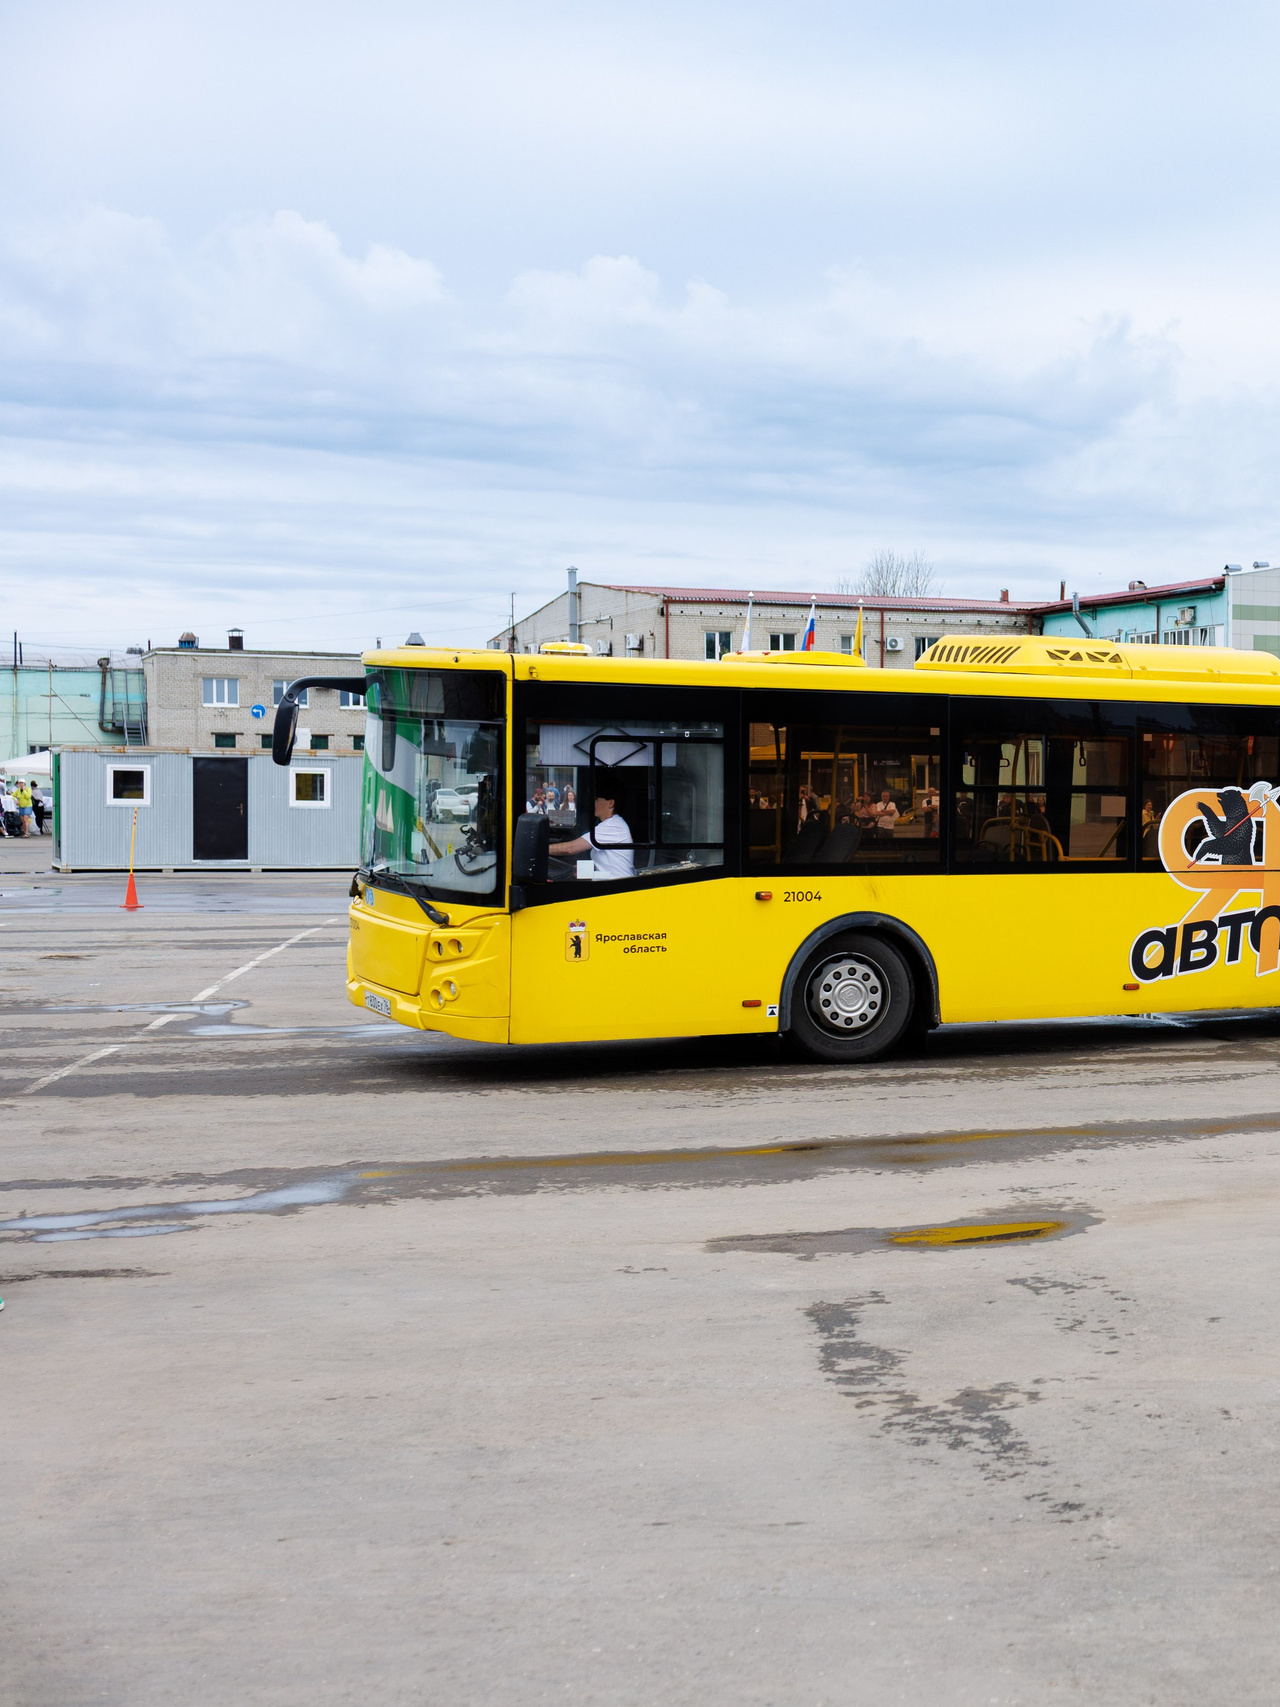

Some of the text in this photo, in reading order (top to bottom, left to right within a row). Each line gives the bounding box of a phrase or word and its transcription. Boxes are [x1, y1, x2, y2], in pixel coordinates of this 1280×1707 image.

[783, 891, 822, 903] 21004
[595, 932, 667, 944] Ярославская
[623, 944, 668, 954] область
